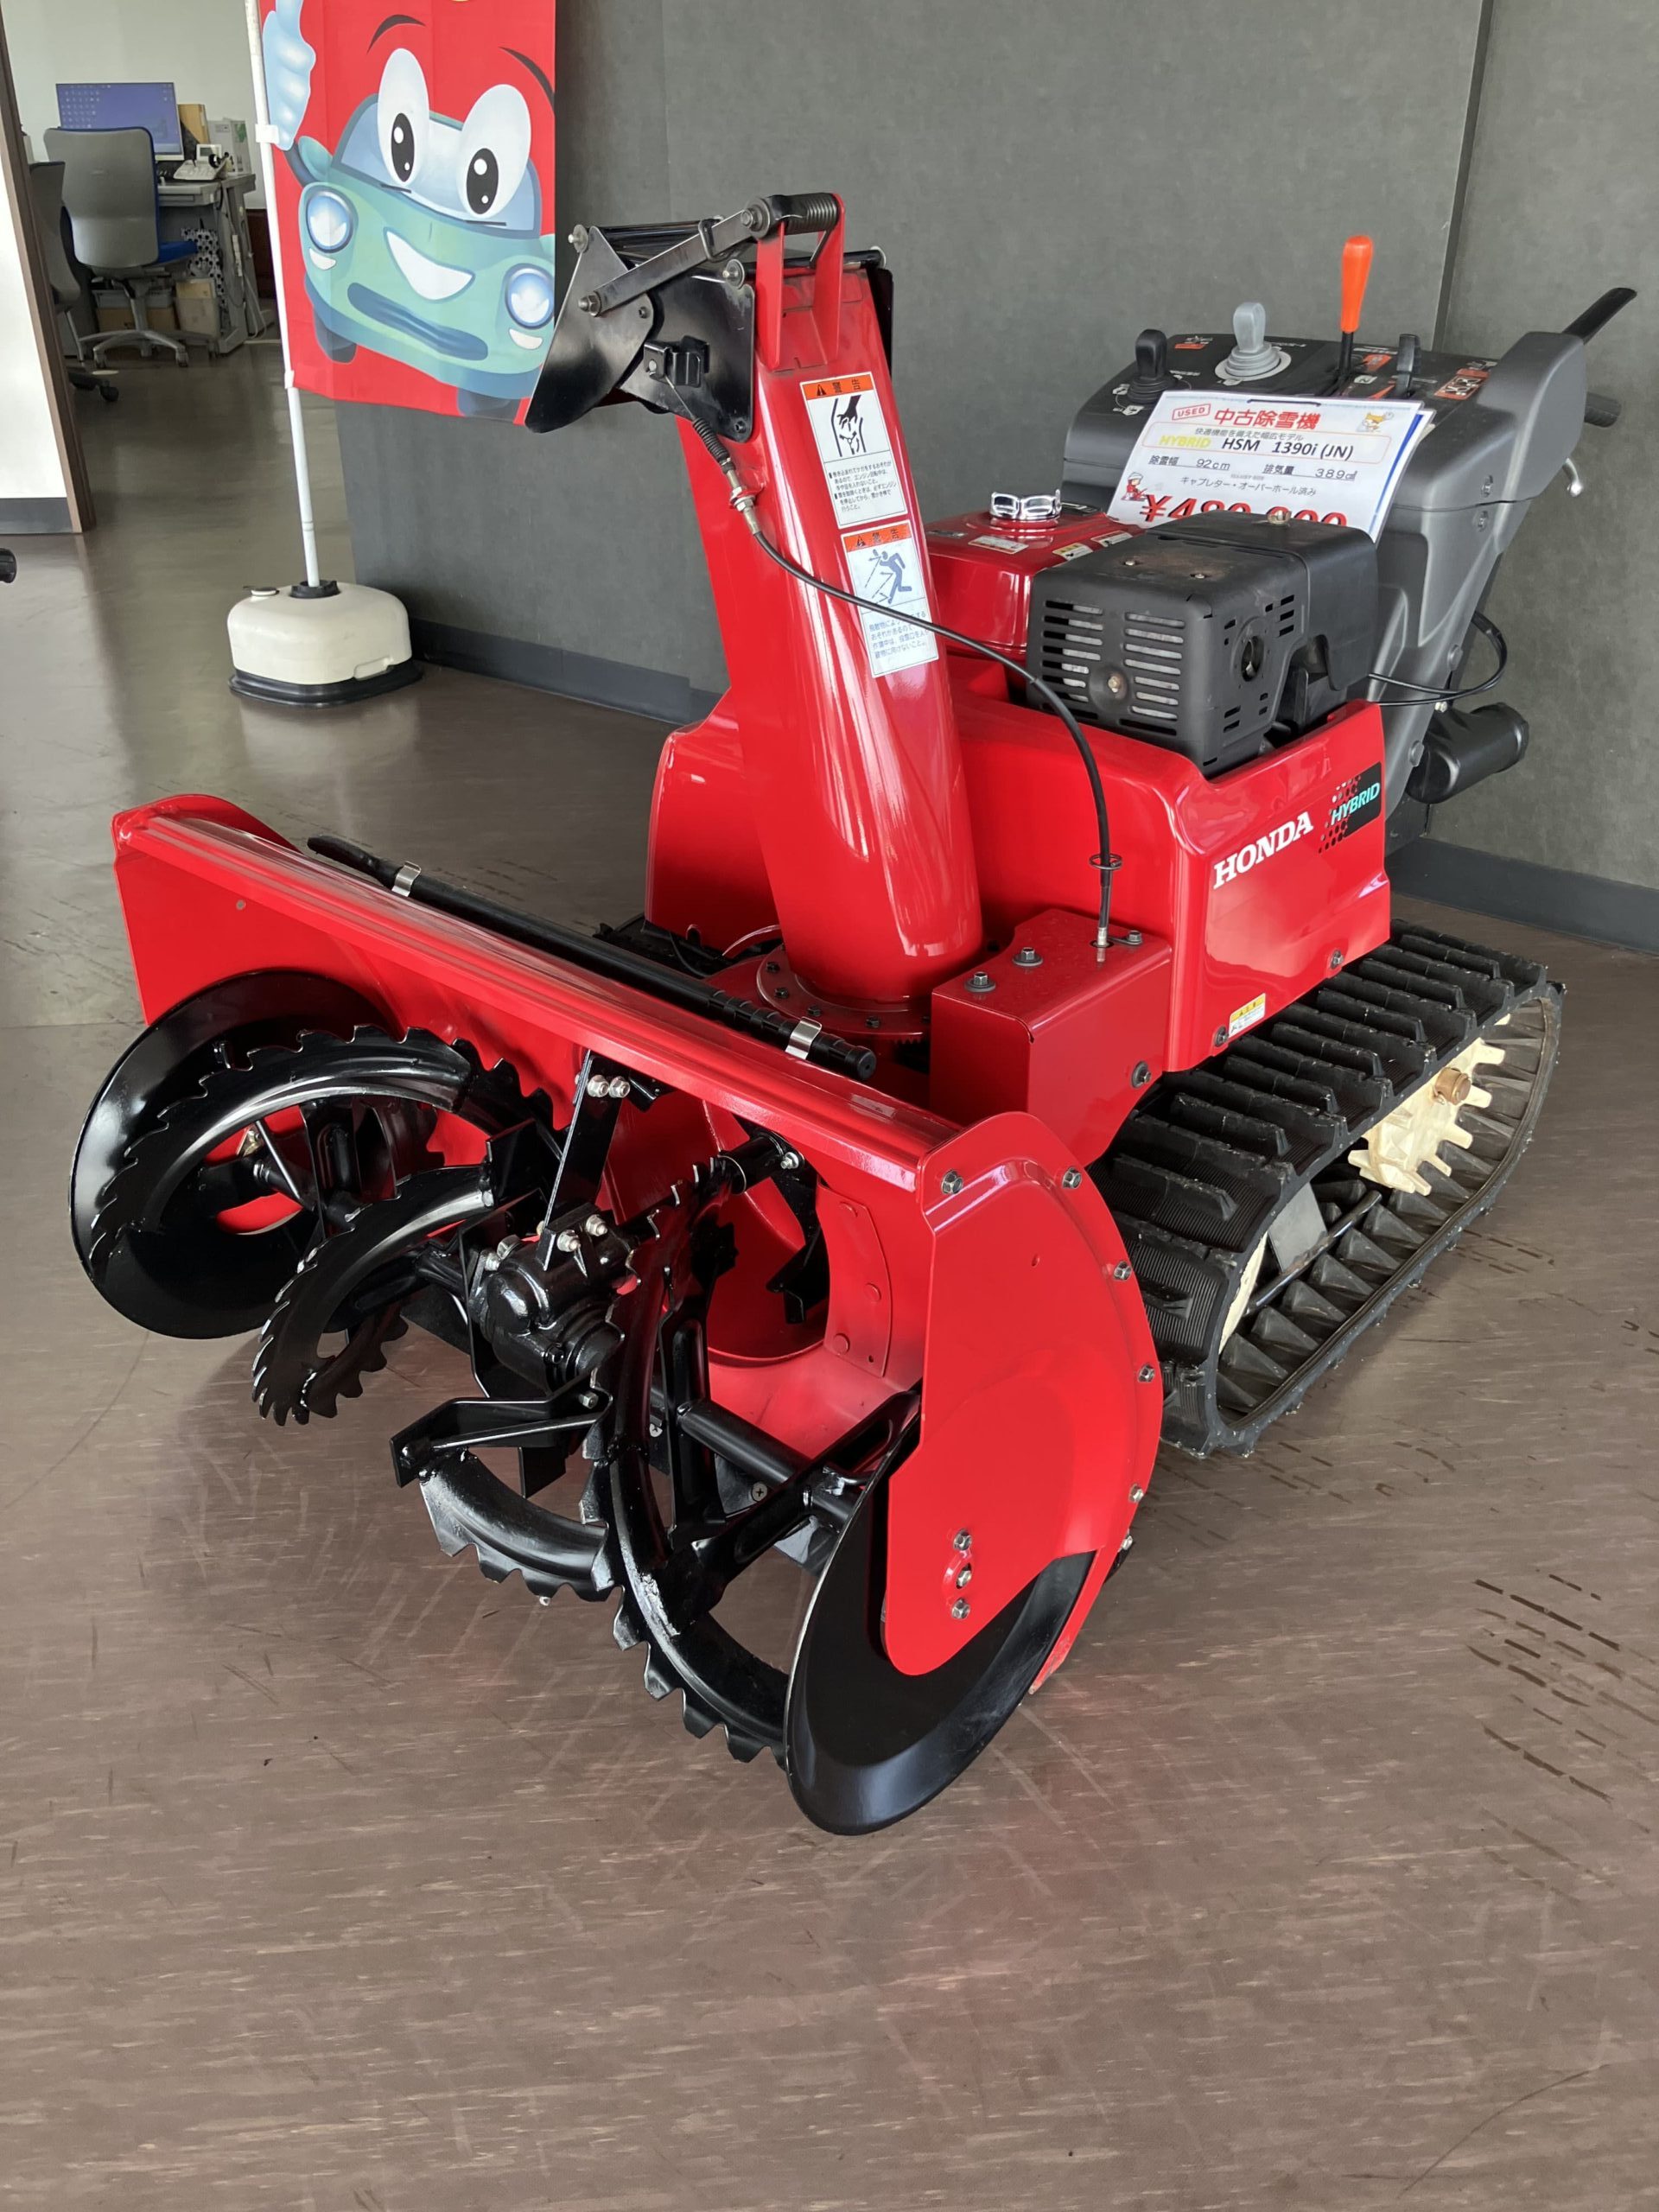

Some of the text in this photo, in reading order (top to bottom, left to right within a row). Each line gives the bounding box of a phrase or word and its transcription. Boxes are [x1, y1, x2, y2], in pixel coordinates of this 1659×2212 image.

[1178, 407, 1205, 417] USED
[1214, 408, 1321, 429] 中古除雪機
[1160, 435, 1353, 461] HYBRID HSM 1390i (JN)
[1262, 463, 1294, 475] 排気量
[1331, 782, 1380, 825] HYBRID
[1213, 811, 1313, 889] HONDA
